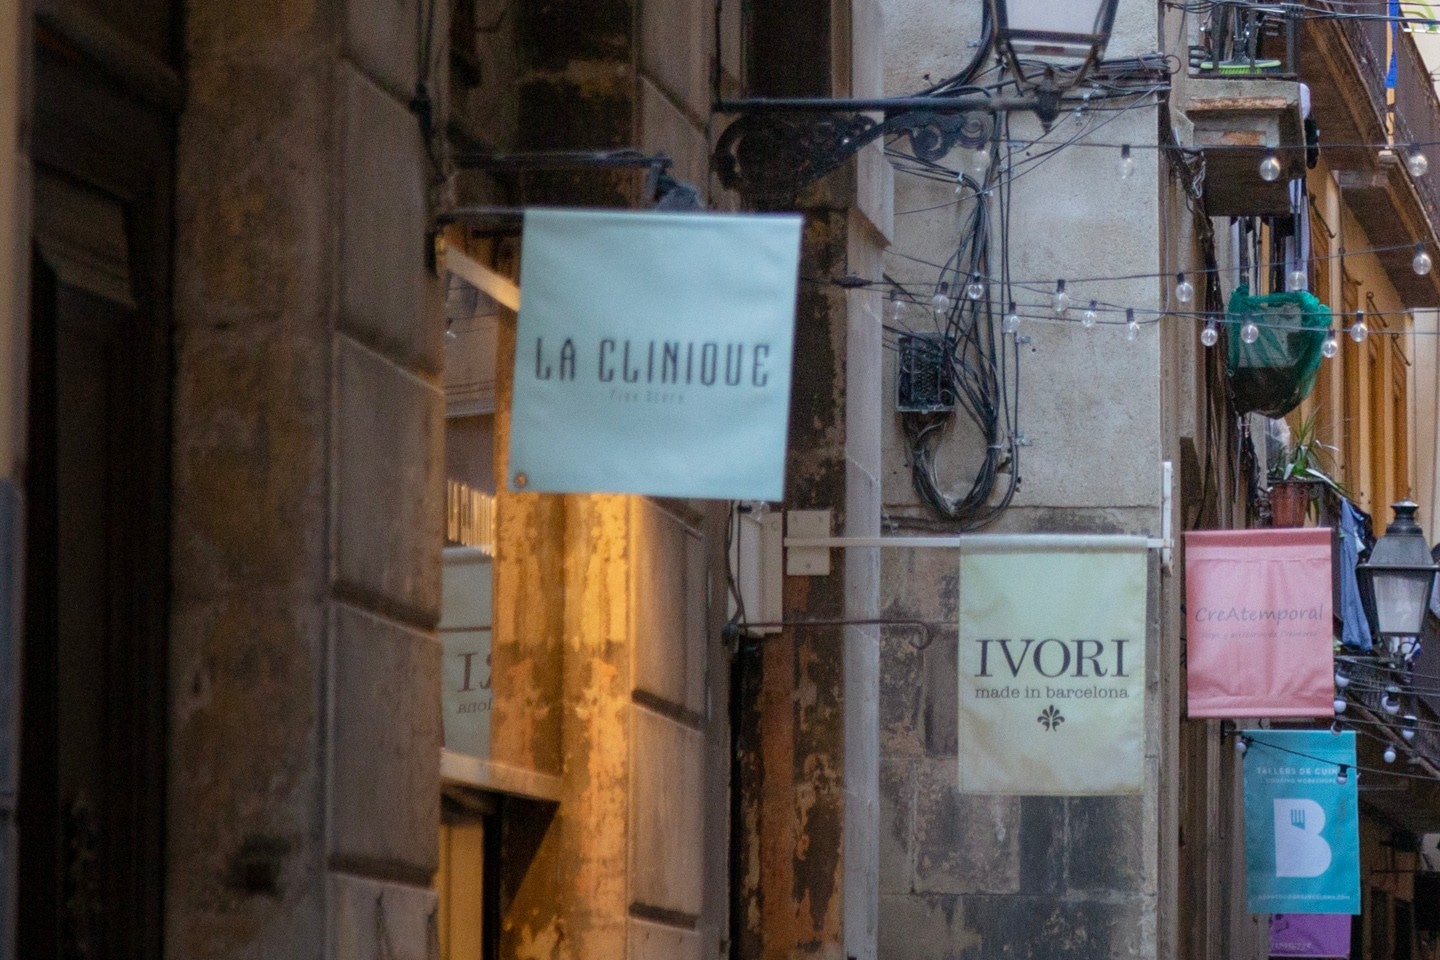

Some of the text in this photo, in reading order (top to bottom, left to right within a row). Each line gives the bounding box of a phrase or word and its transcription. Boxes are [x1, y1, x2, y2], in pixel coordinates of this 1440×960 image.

[535, 336, 771, 389] LA CLINIQUE
[1195, 604, 1324, 626] CreAtemporal
[974, 638, 1130, 679] IVORI
[975, 686, 1130, 700] made in barcelona
